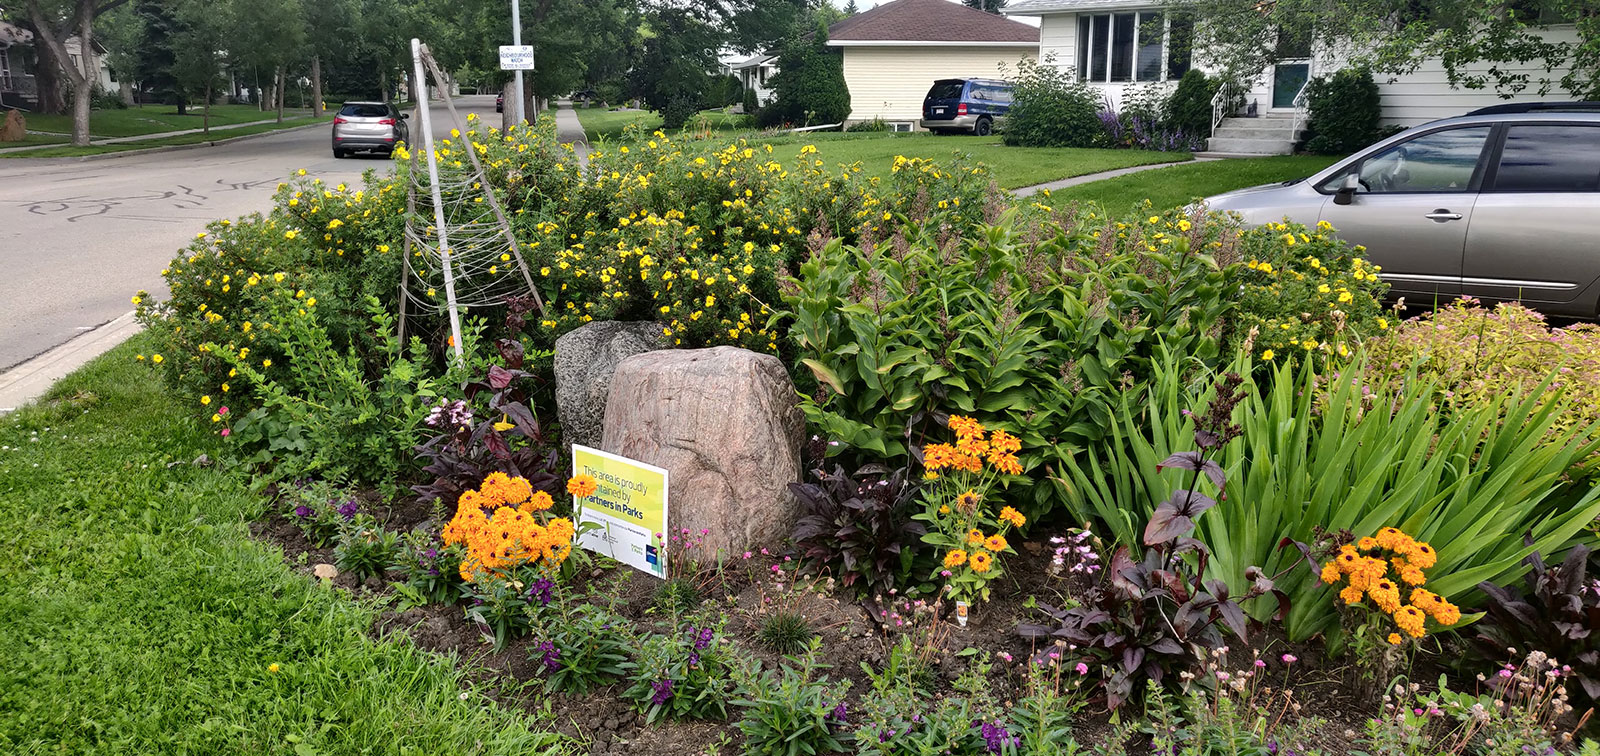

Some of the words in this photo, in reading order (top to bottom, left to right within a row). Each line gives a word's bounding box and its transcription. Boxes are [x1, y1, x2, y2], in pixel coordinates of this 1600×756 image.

[584, 465, 597, 478] This
[599, 472, 613, 483] area
[615, 474, 620, 485] is
[621, 479, 648, 496] proudly
[584, 495, 614, 510] Partners
[615, 501, 621, 512] in
[623, 504, 643, 519] Parks
[623, 490, 631, 504] by
